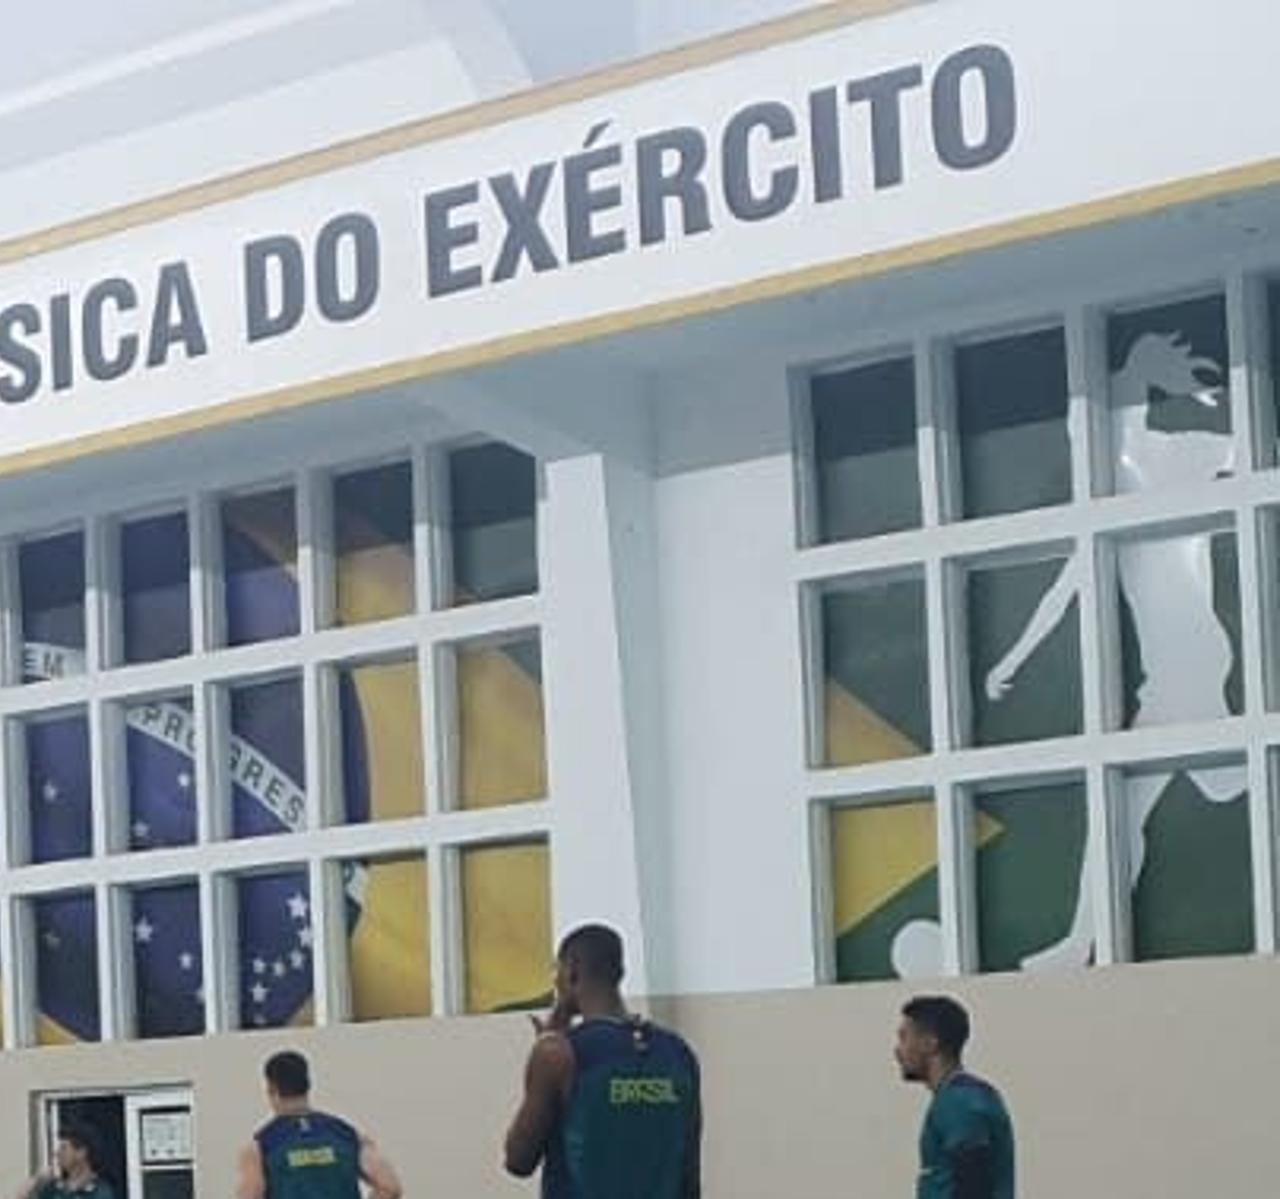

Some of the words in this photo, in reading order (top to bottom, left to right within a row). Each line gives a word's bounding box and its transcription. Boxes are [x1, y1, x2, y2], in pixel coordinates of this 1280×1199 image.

[244, 213, 380, 344] DO
[424, 44, 1017, 299] EXÉRCITO
[610, 1077, 680, 1104] BRASIL
